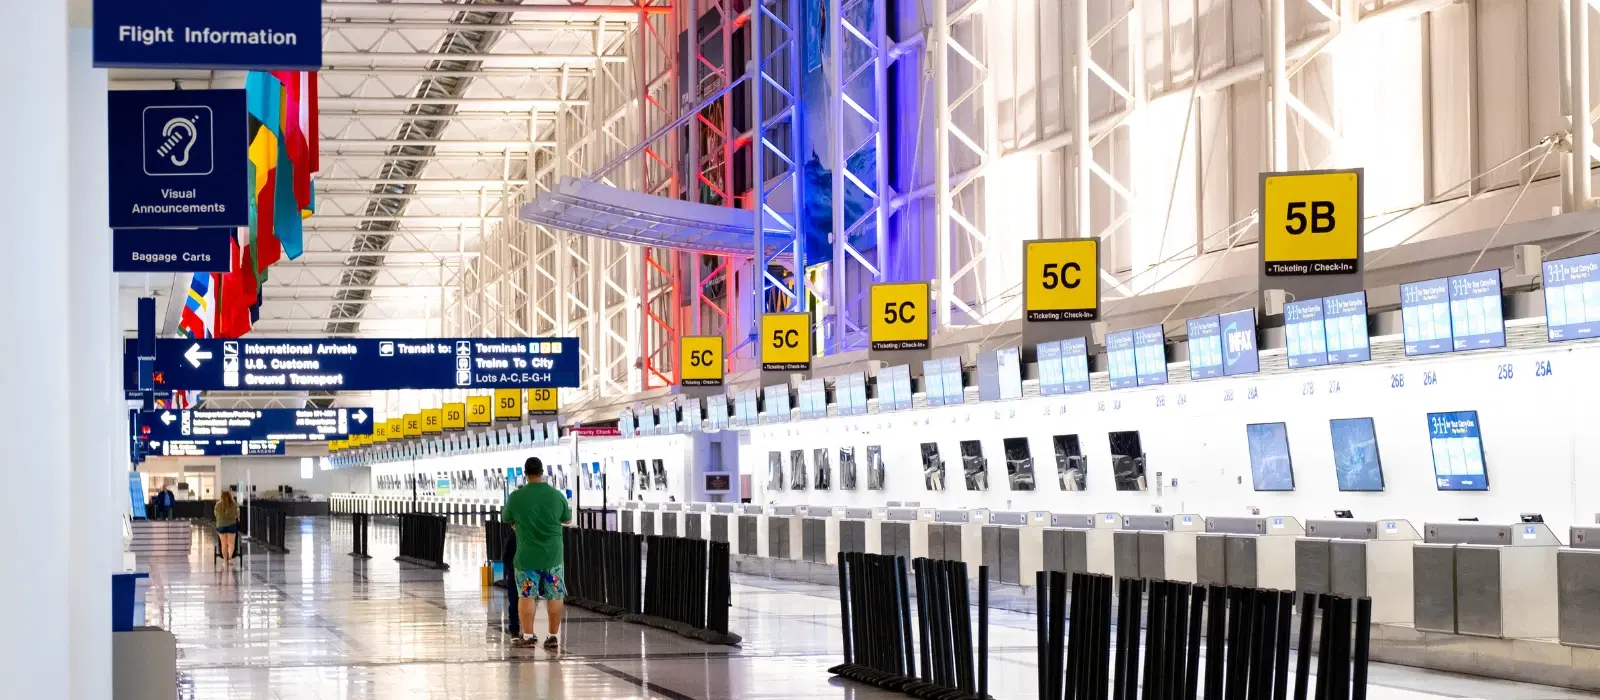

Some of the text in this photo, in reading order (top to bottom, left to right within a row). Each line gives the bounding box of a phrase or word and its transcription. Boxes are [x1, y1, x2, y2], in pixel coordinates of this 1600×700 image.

[119, 25, 297, 45] Flight Information
[161, 188, 196, 199] Visual
[132, 203, 226, 214] Announcements
[1285, 201, 1336, 235] 5B
[132, 252, 211, 263] Baggage Carts
[1272, 264, 1308, 274] Ticketing
[1314, 263, 1349, 271] Check-In
[1042, 262, 1081, 289] 5C
[884, 301, 916, 324] 5C
[1033, 312, 1060, 320] Ticketing
[1063, 311, 1090, 319] Check-In
[773, 329, 799, 348] 5C
[244, 344, 357, 355] International Arrivals
[397, 343, 452, 354] Transit to:
[475, 343, 527, 354] Terminals
[690, 349, 713, 366] 5C
[244, 359, 320, 369] U.S. Customs
[475, 358, 554, 369] Trains To City
[1535, 360, 1553, 377] 25A
[1497, 363, 1514, 380] 25B
[244, 373, 343, 386] Ground Transport
[475, 373, 497, 383] Lots
[1390, 373, 1405, 388] 26B
[1423, 371, 1438, 386] 26A
[535, 389, 551, 401] 5D
[500, 397, 516, 409] 5D
[472, 404, 485, 415] 5D
[426, 416, 437, 425] 5E
[447, 411, 460, 420] 5D
[391, 424, 401, 433] 5E
[408, 420, 418, 429] 5E
[376, 428, 386, 436] 5E
